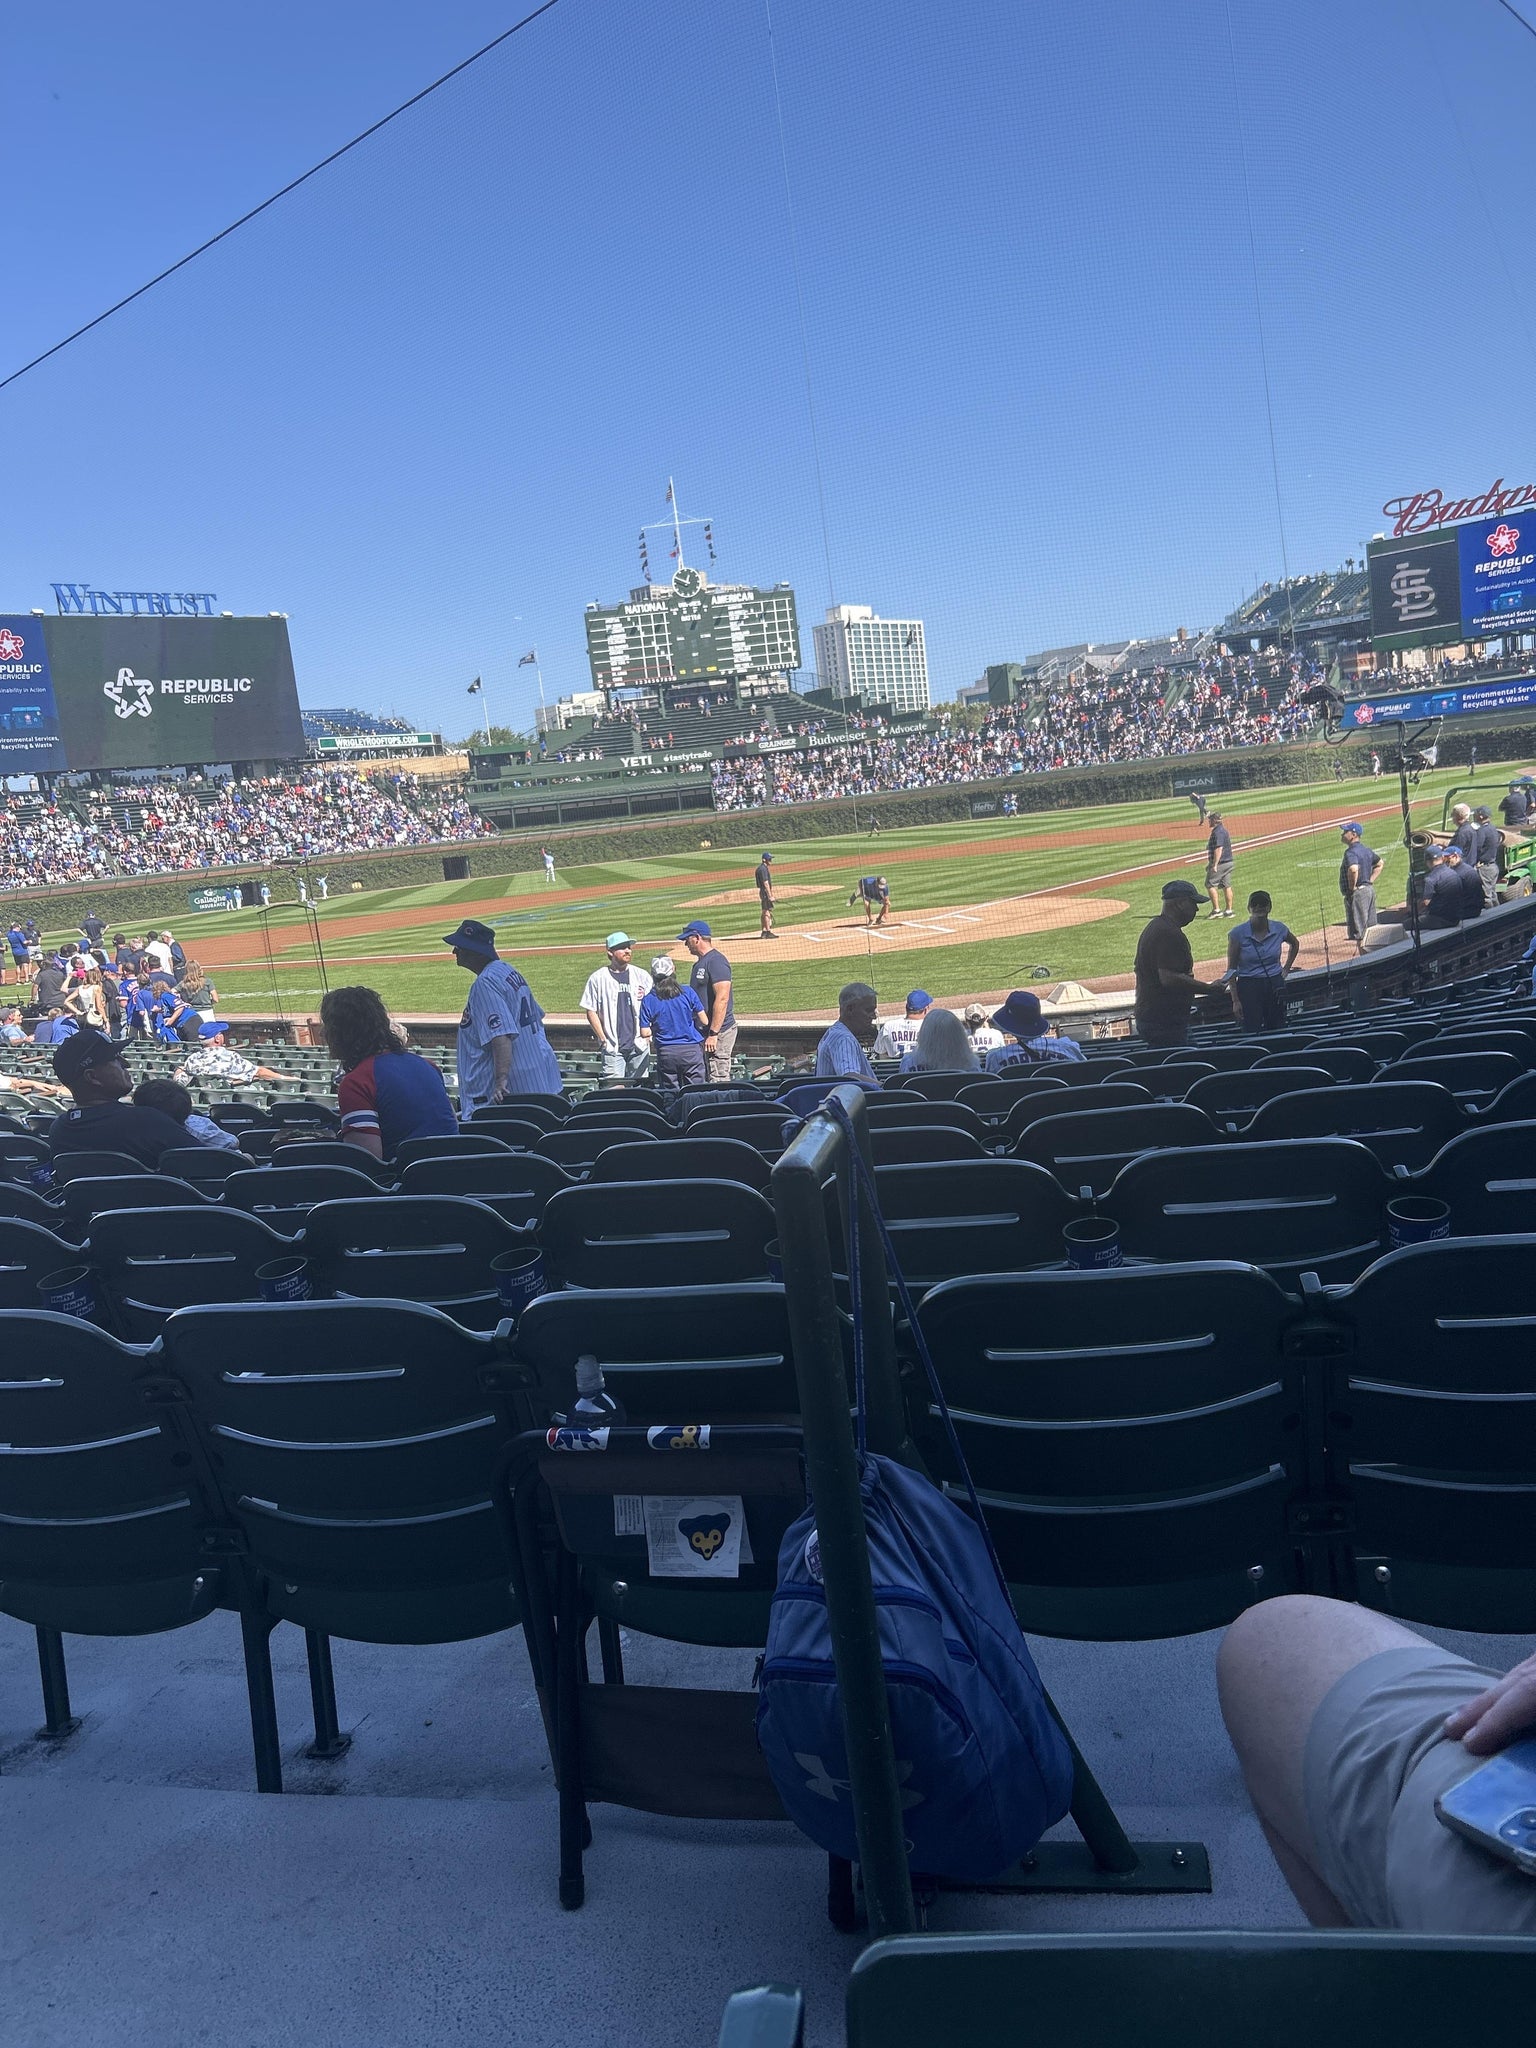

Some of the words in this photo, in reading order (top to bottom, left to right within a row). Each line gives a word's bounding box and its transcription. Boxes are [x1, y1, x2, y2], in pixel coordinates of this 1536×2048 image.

[1382, 478, 1536, 537] Budw
[1475, 554, 1535, 574] REPUBLIC
[1488, 566, 1521, 577] SERVICES
[50, 584, 218, 615] WINTRUST
[711, 592, 754, 605] AMERICAN
[624, 602, 669, 614] NATIONAL
[1473, 612, 1516, 624] Environmental
[161, 678, 252, 694] REPUBLIC
[183, 693, 235, 704] SERVICES
[1462, 687, 1516, 701] Environmental
[1375, 702, 1411, 713] REPUBLIC
[1462, 699, 1498, 709] Recycling
[1505, 695, 1529, 704] Waste
[889, 722, 928, 735] Advocate
[335, 734, 419, 748] WRIGLEYROOFTOPS.COM
[758, 738, 797, 750] GRAINGER
[620, 755, 652, 768] YETI
[668, 750, 713, 762] tastytrade
[1174, 776, 1213, 789] SLOAN
[973, 801, 997, 813] Hefty
[193, 894, 228, 905] Gallaghe
[891, 1030, 919, 1042] DARVI
[1095, 1246, 1118, 1260] Hefty
[512, 1271, 534, 1286] Hefty
[51, 1292, 75, 1303] Hefty
[64, 1296, 87, 1310] Hefty
